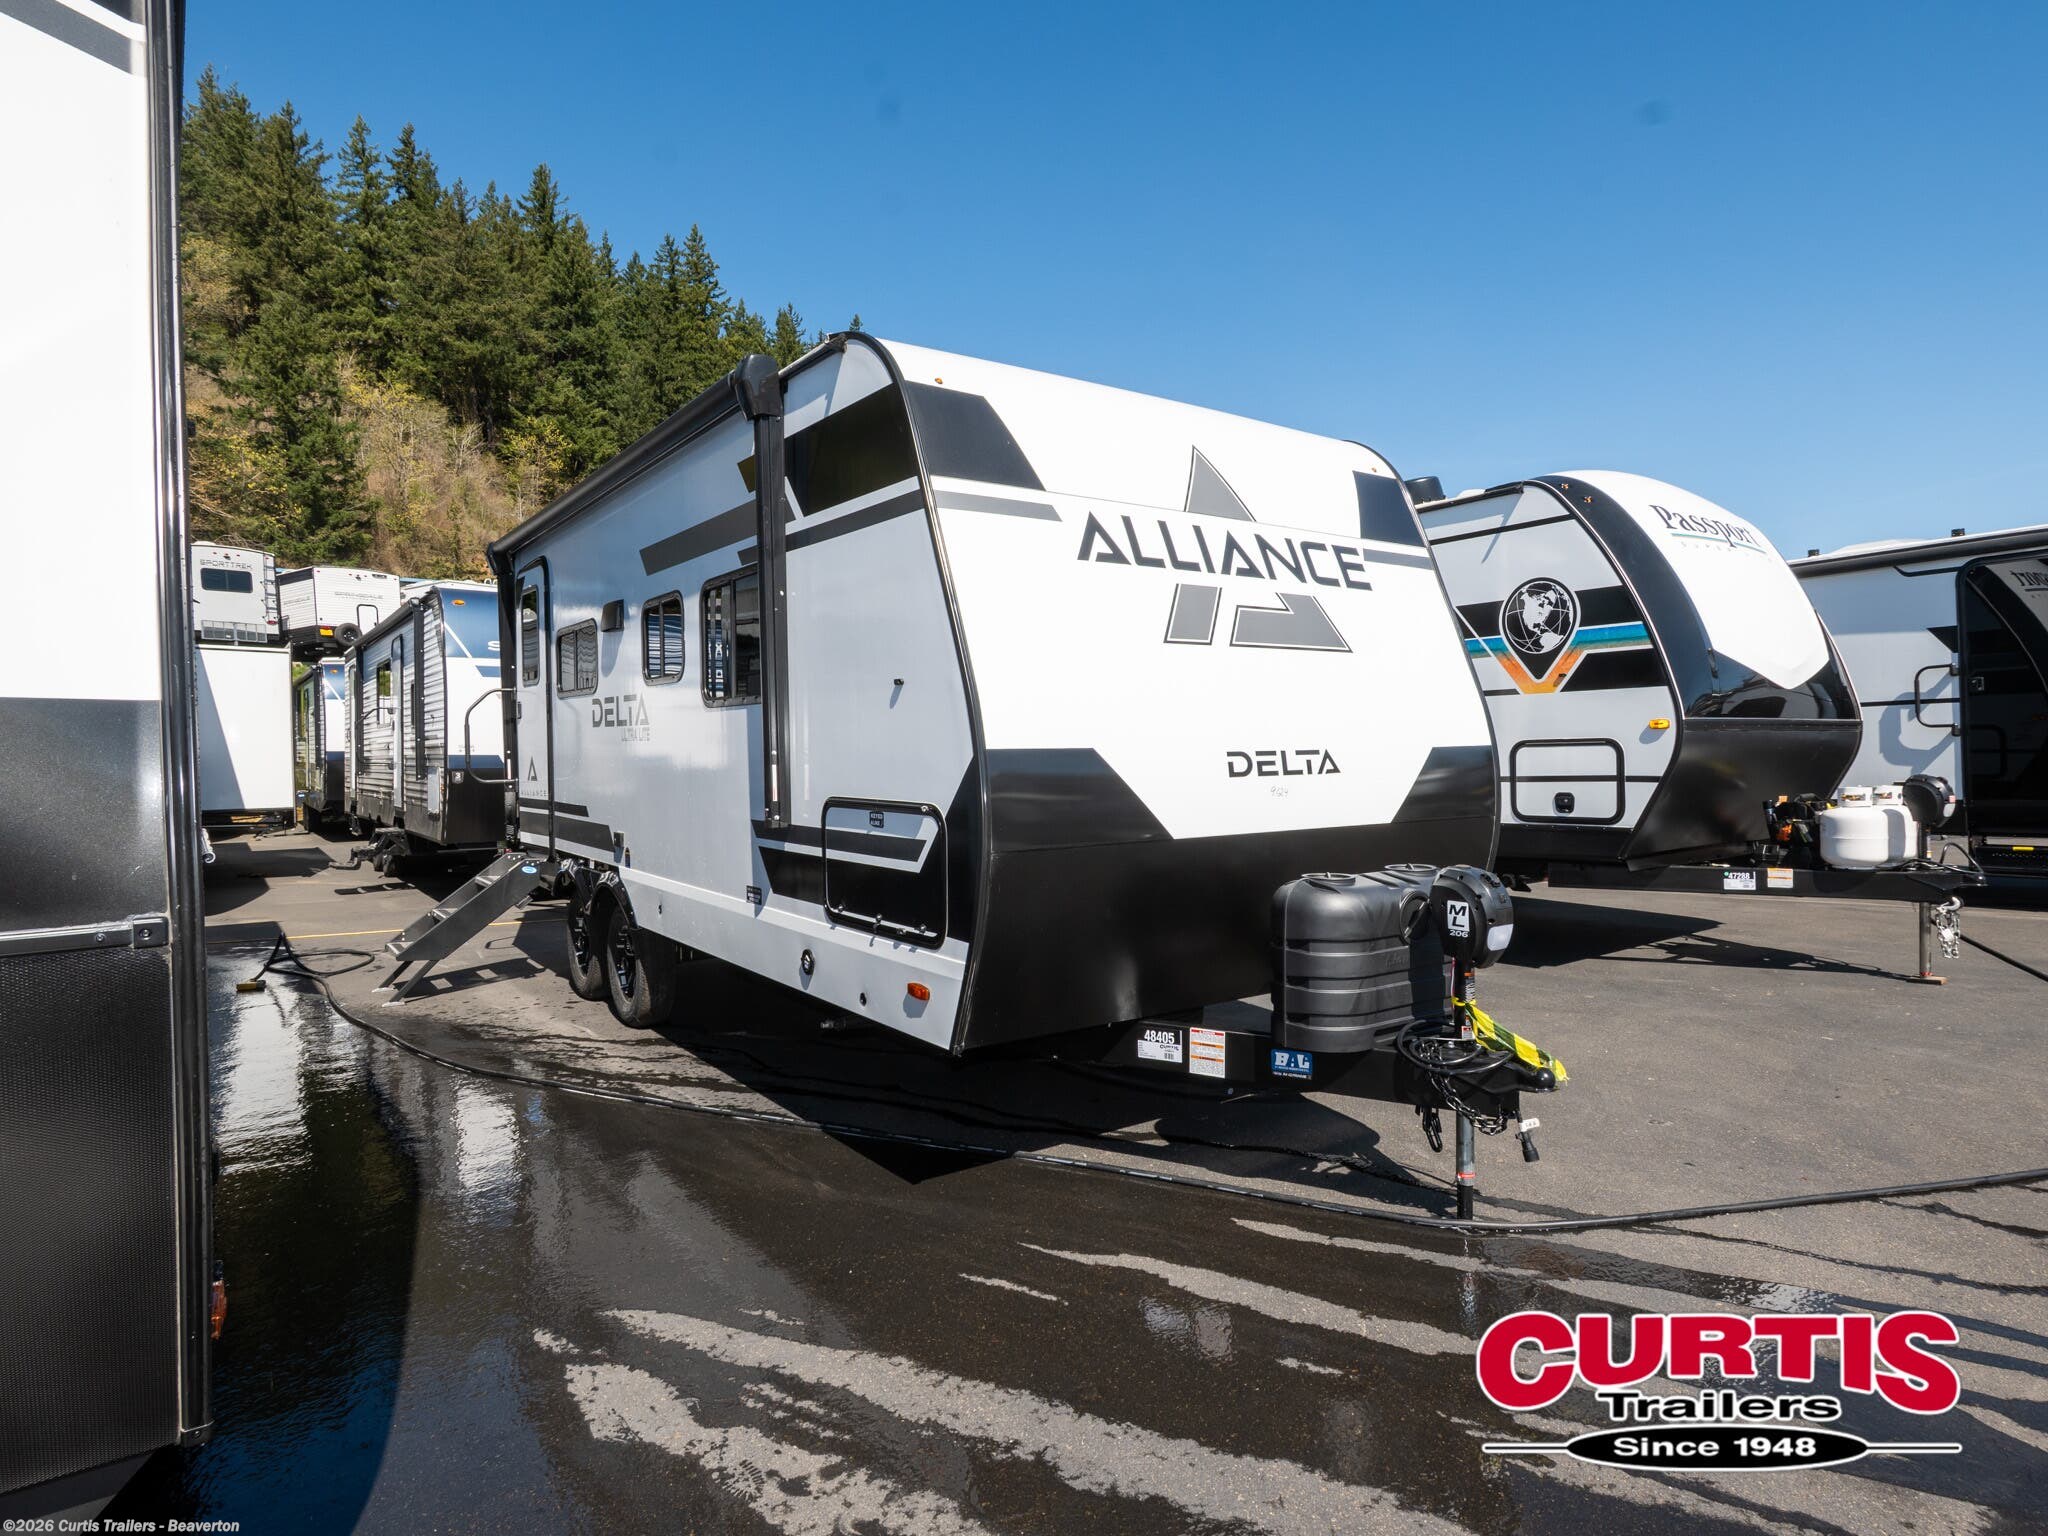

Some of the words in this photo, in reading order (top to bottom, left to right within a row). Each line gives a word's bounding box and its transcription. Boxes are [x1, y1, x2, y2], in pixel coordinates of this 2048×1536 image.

[1648, 505, 1761, 548] Passport
[199, 559, 253, 569] SPORTTREK
[1077, 511, 1373, 591] ALLIANCE
[592, 693, 650, 728] DELTA
[1226, 749, 1341, 778] DELTA
[1449, 929, 1469, 938] 206
[1143, 1029, 1176, 1045] 48405
